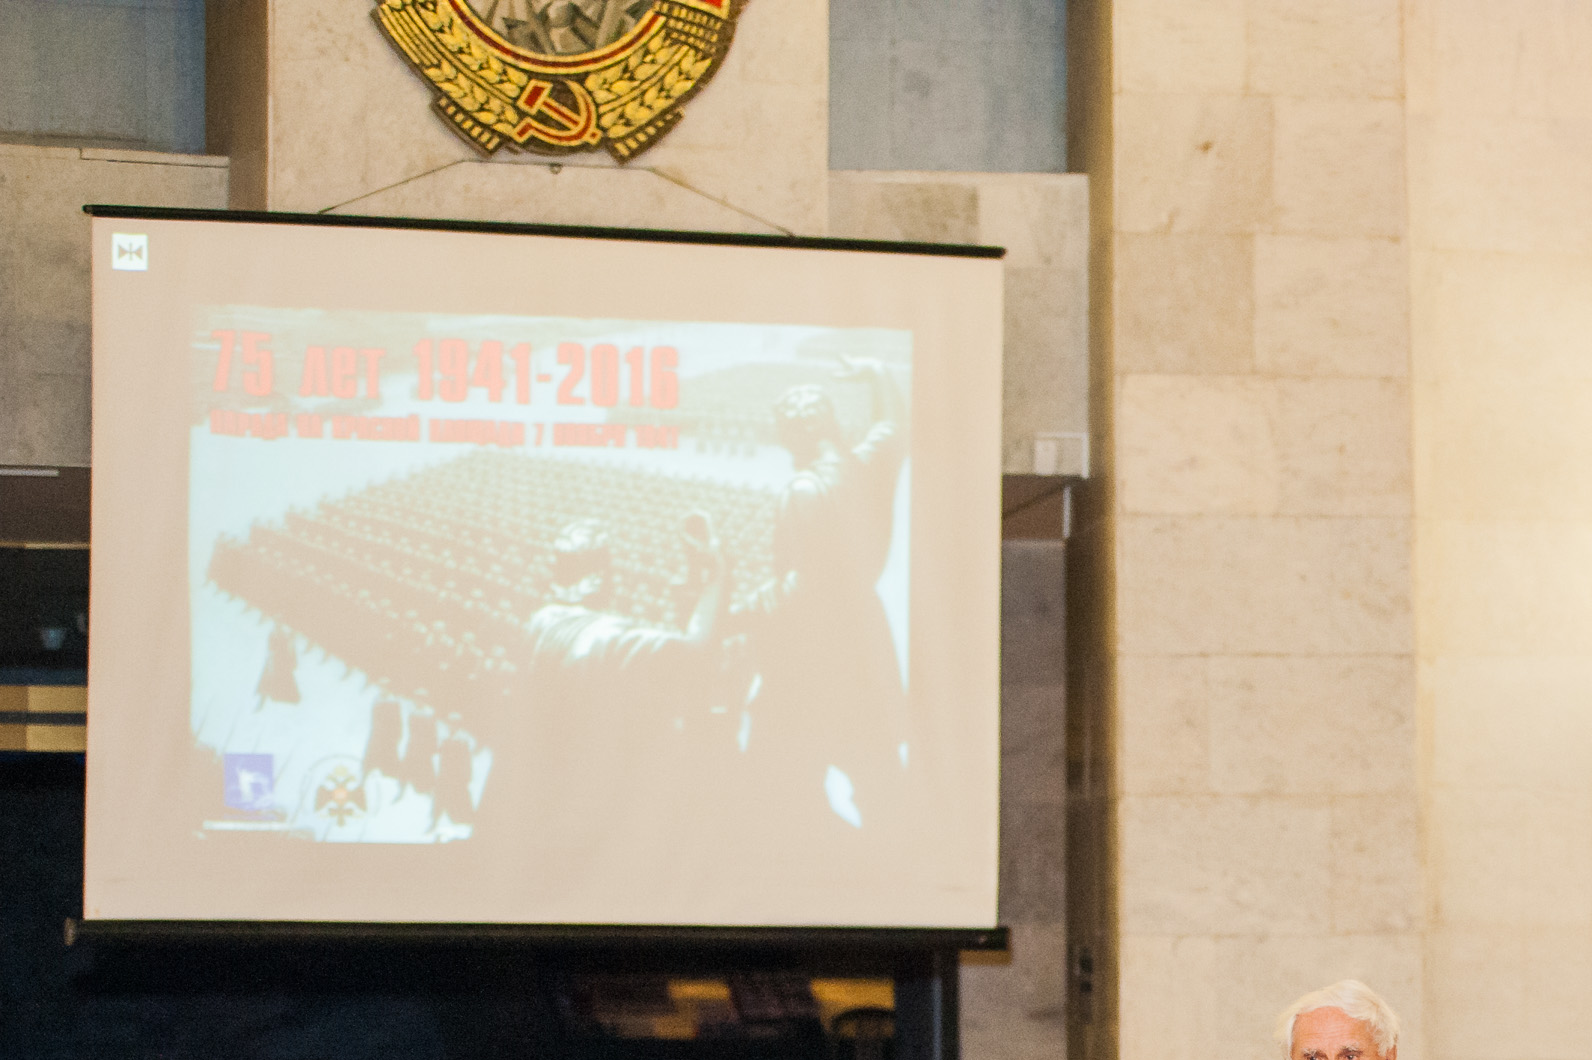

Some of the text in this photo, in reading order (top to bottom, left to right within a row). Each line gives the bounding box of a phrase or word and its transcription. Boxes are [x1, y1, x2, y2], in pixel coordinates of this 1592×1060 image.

[212, 329, 680, 410] 75 лет 1941-2016
